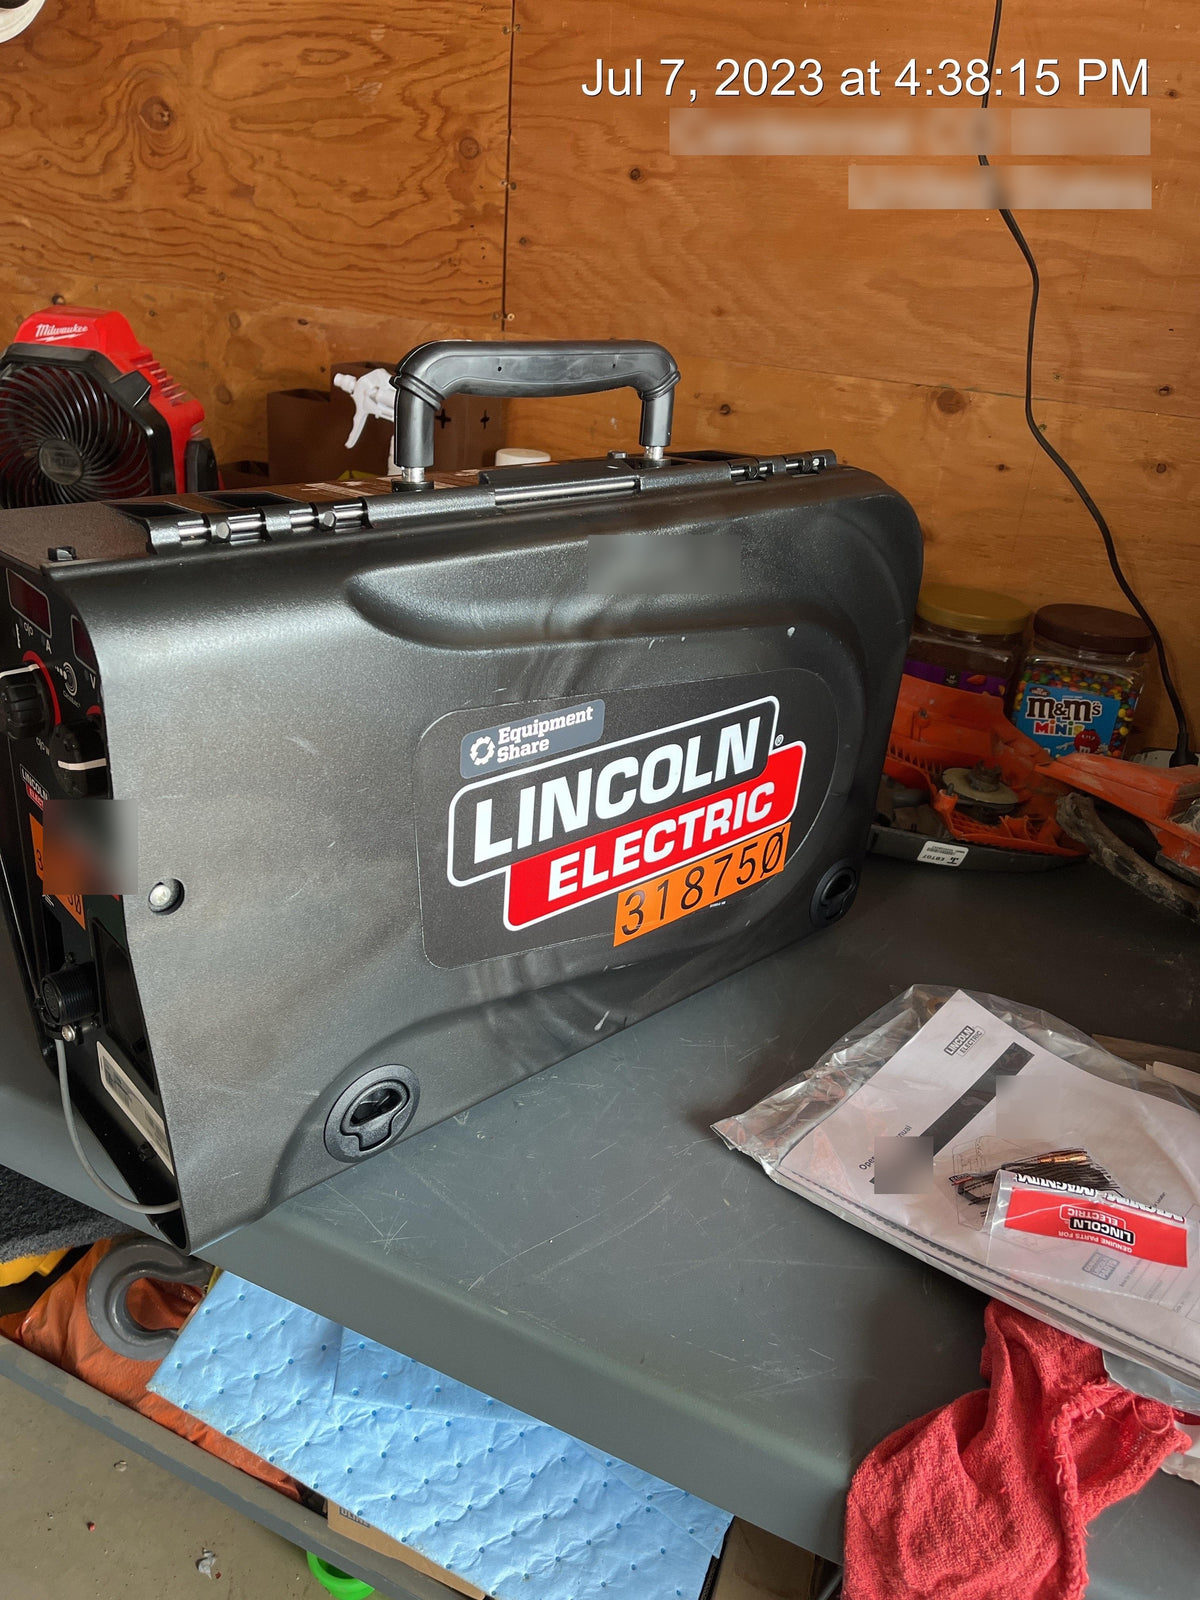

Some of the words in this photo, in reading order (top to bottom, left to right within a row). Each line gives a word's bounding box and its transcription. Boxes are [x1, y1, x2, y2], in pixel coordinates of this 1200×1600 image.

[35, 323, 88, 338] Milwaukee
[498, 705, 594, 743] Equipment
[497, 738, 550, 763] Share
[21, 768, 48, 800] LINCOLN
[473, 716, 761, 864] LINCOLN
[548, 781, 775, 902] ELECTRIC
[621, 828, 788, 936] 318750
[945, 1026, 974, 1055] LINCOLN
[960, 1030, 983, 1054] ELECTRIC
[1067, 1208, 1118, 1226] ELECTRIC
[1058, 1230, 1074, 1239] FOR
[1073, 1218, 1131, 1242] LINCOLN
[1075, 1233, 1099, 1243] PARTS
[1100, 1238, 1133, 1254] GENUINE
